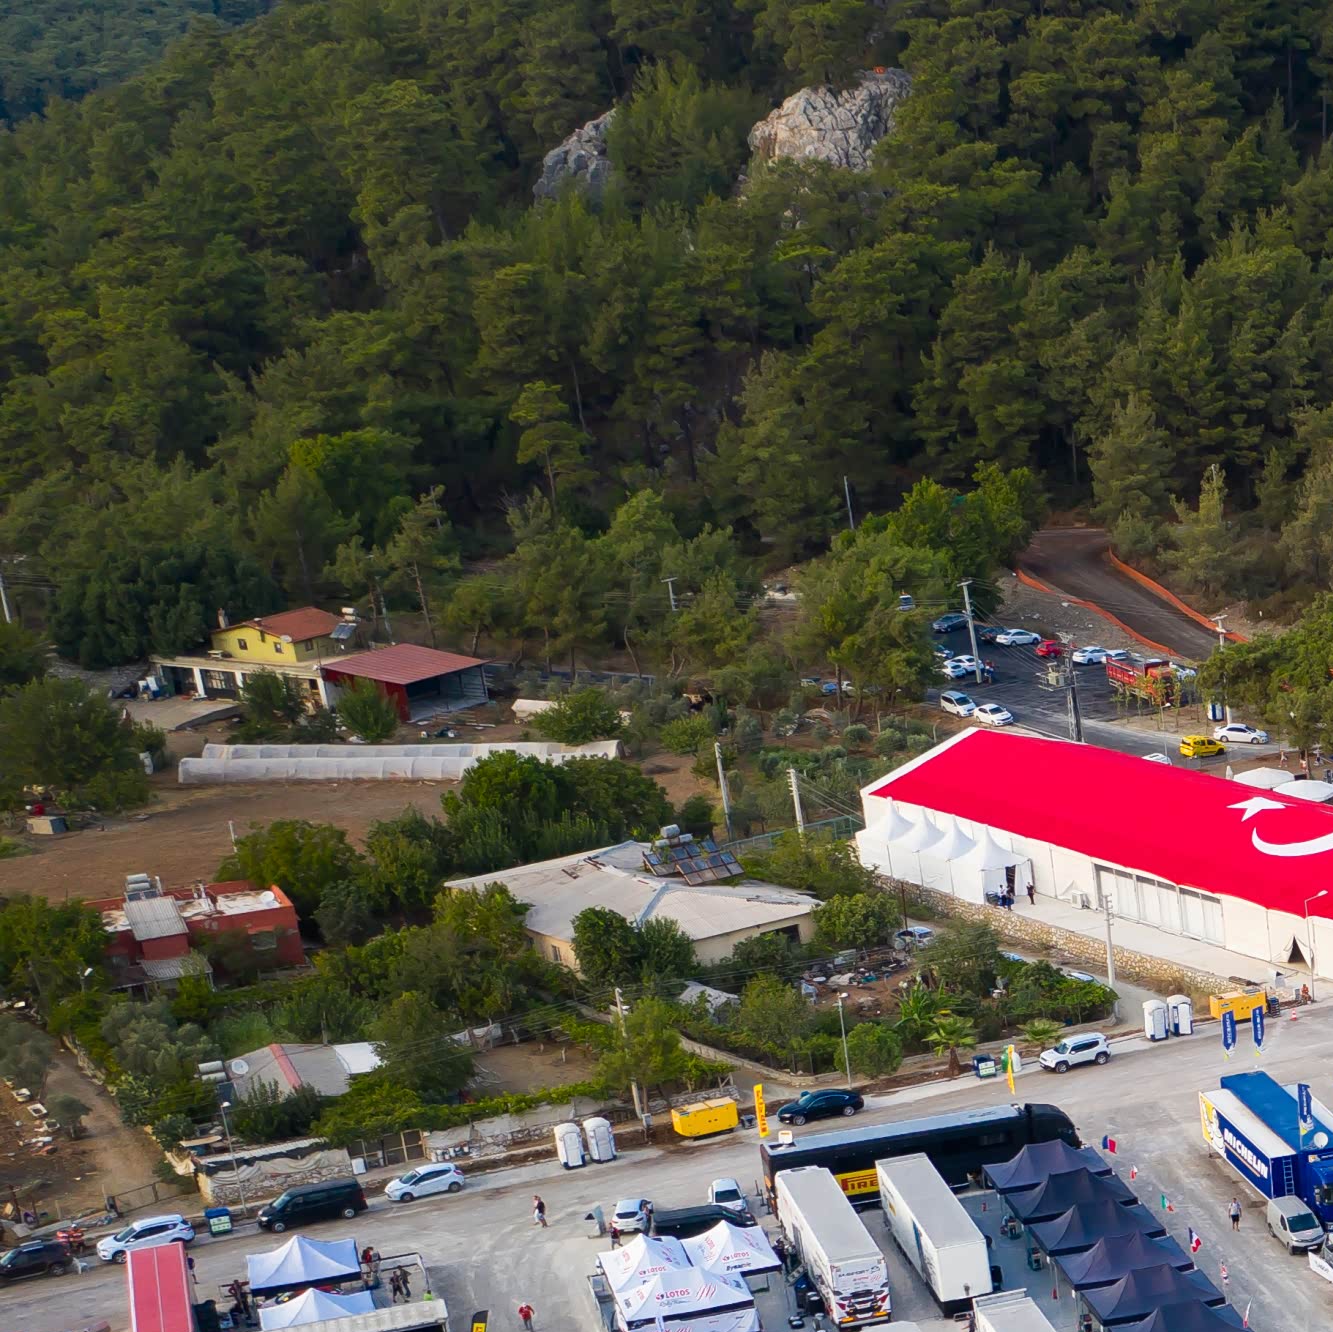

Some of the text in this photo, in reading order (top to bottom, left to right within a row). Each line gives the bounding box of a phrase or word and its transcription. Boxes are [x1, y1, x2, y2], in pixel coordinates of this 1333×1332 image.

[1224, 1127, 1269, 1180] MICHELIN
[841, 1172, 879, 1192] PIRE
[729, 1251, 750, 1260] LOTOS
[646, 1265, 667, 1276] LOTOS
[664, 1287, 691, 1299] LOTOS
